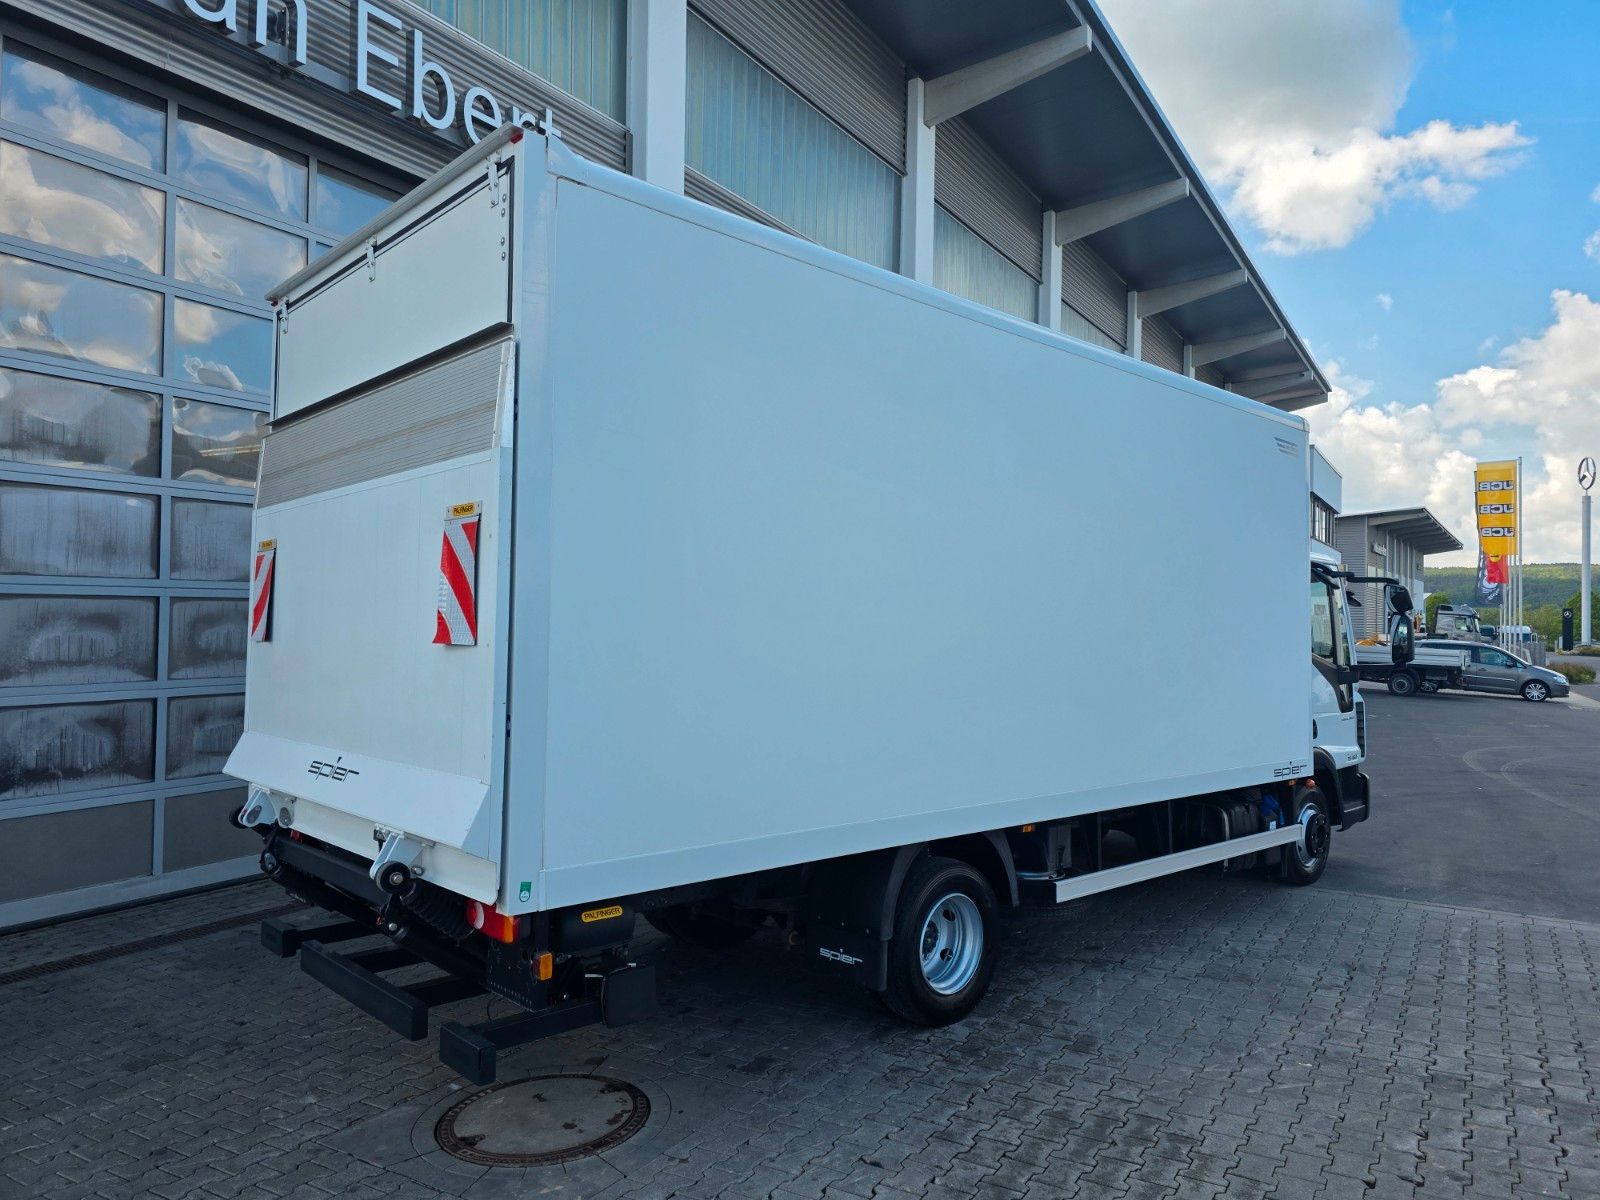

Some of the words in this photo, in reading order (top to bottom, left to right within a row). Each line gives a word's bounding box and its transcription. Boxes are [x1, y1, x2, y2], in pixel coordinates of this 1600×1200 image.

[307, 756, 360, 782] spier
[1273, 760, 1307, 779] spier
[583, 907, 621, 921] PALFINGER
[819, 947, 863, 965] spier
